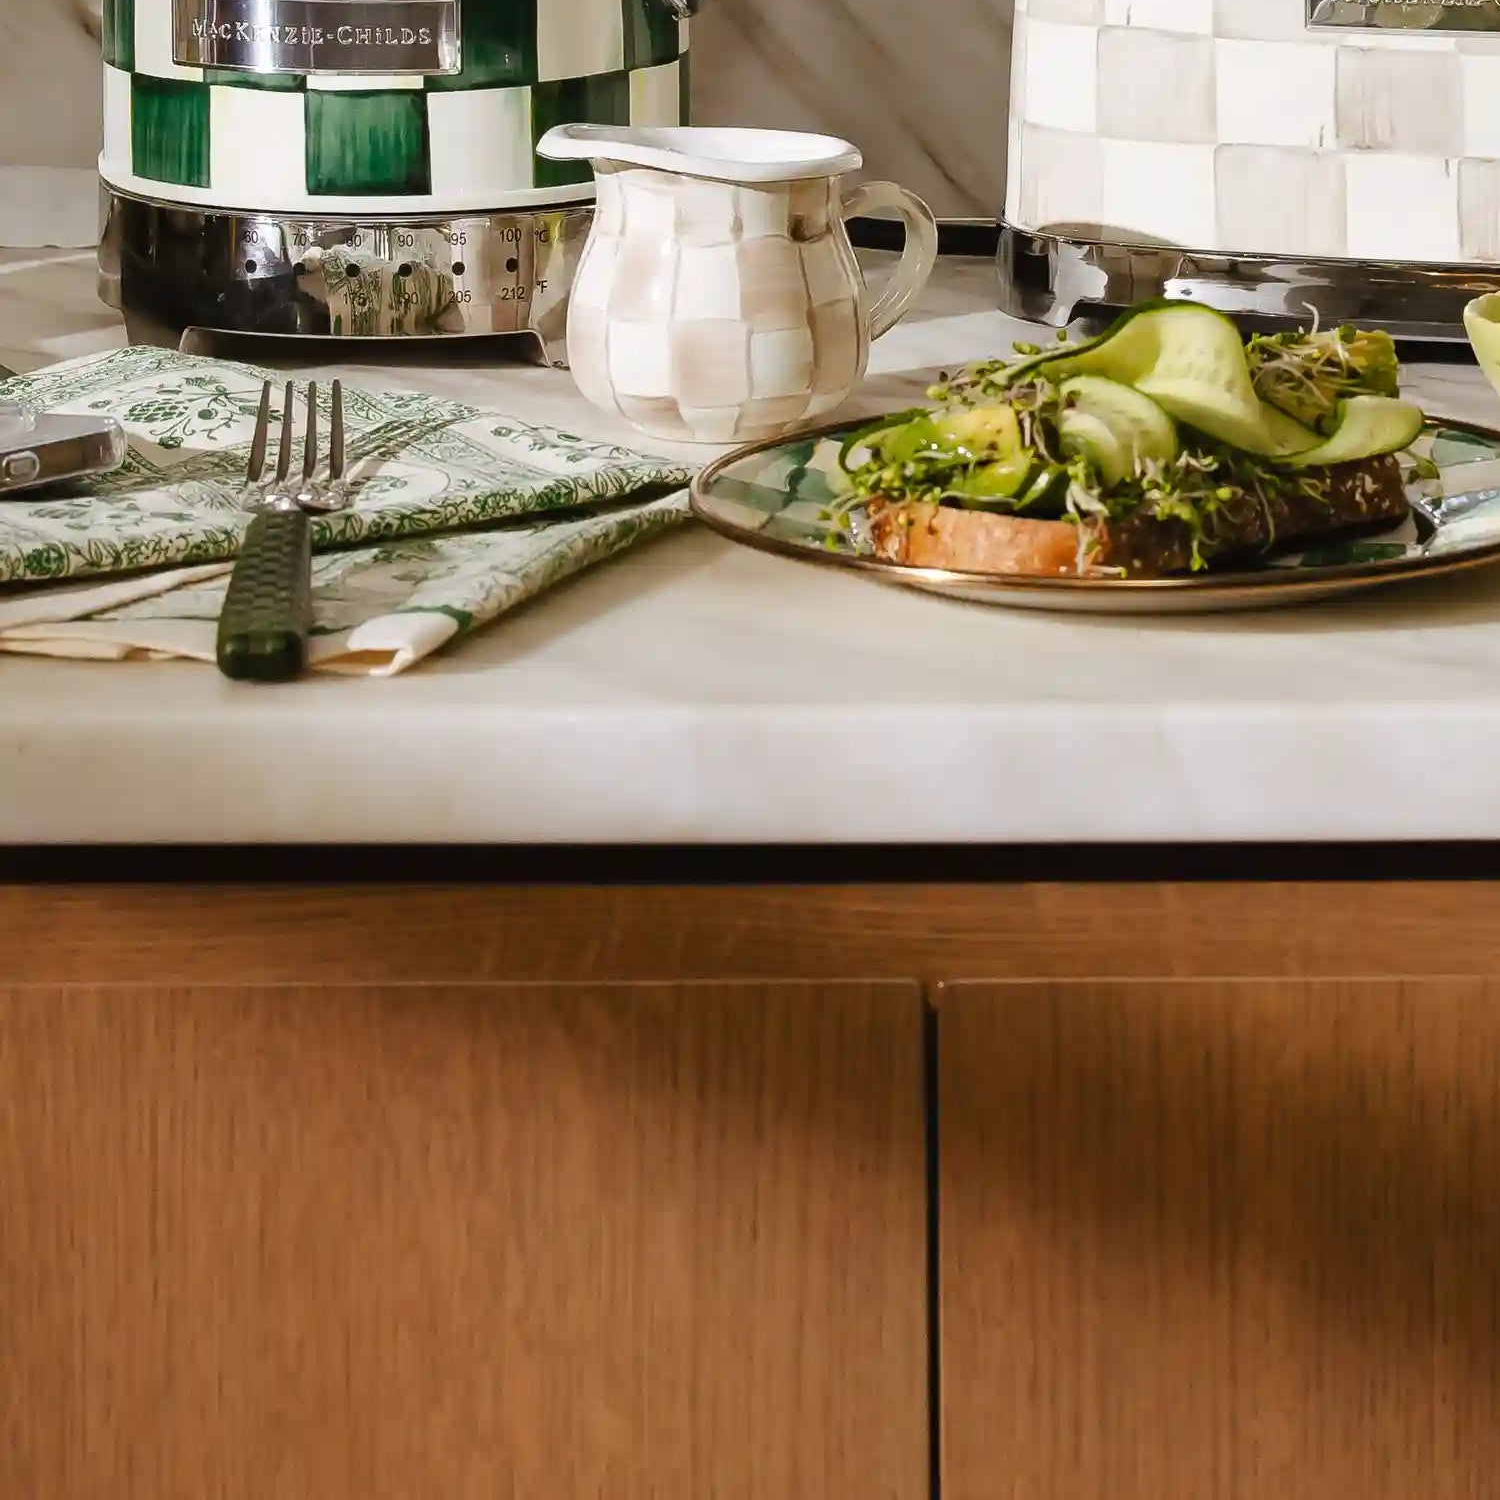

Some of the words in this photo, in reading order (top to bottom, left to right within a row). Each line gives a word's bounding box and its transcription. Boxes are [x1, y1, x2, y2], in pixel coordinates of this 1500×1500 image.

[243, 230, 259, 245] 60
[292, 233, 307, 247] 70
[345, 233, 362, 248] 80
[397, 234, 414, 248] 90
[450, 232, 467, 246] 95
[500, 228, 522, 243] 100
[448, 290, 472, 304] 205
[501, 286, 525, 301] 212
